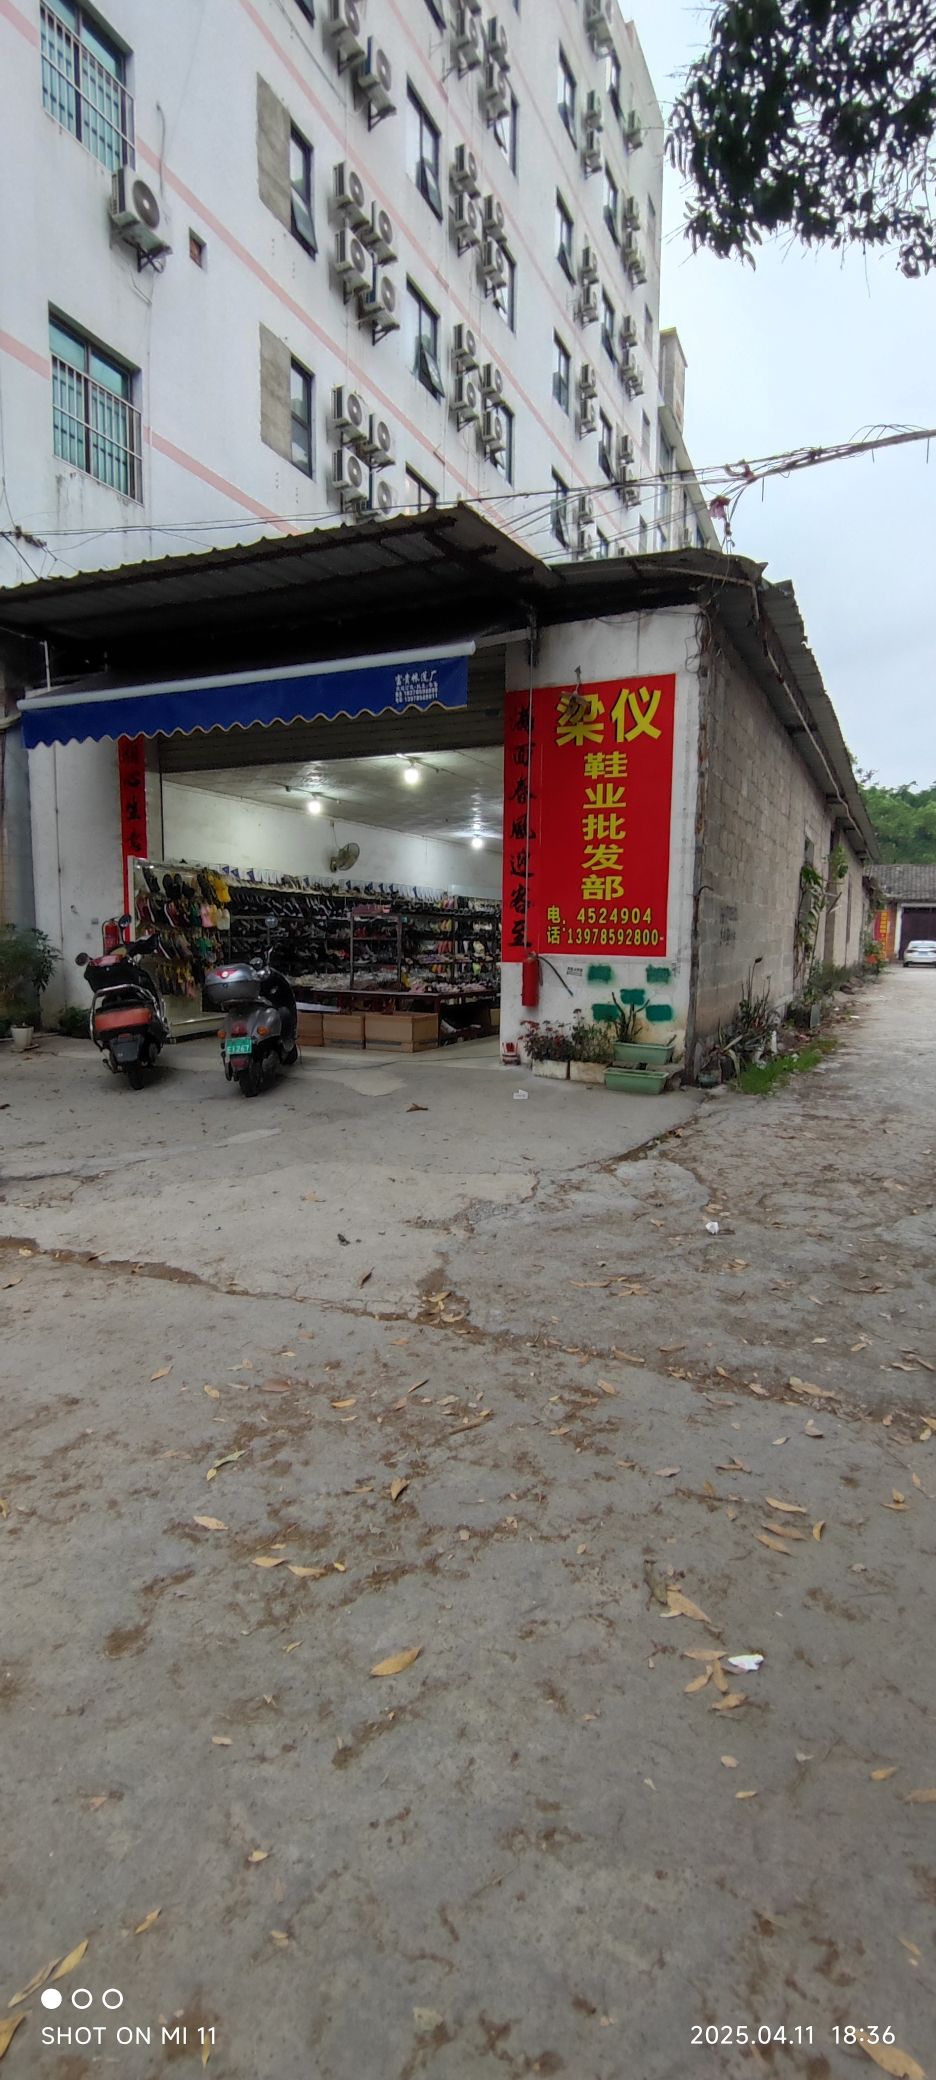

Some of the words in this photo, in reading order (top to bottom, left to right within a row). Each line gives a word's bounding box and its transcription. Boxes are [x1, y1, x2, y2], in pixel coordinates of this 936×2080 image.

[556, 686, 662, 746] 梁仪
[582, 751, 628, 900] 鞋业批发部
[577, 907, 652, 924] 4524904
